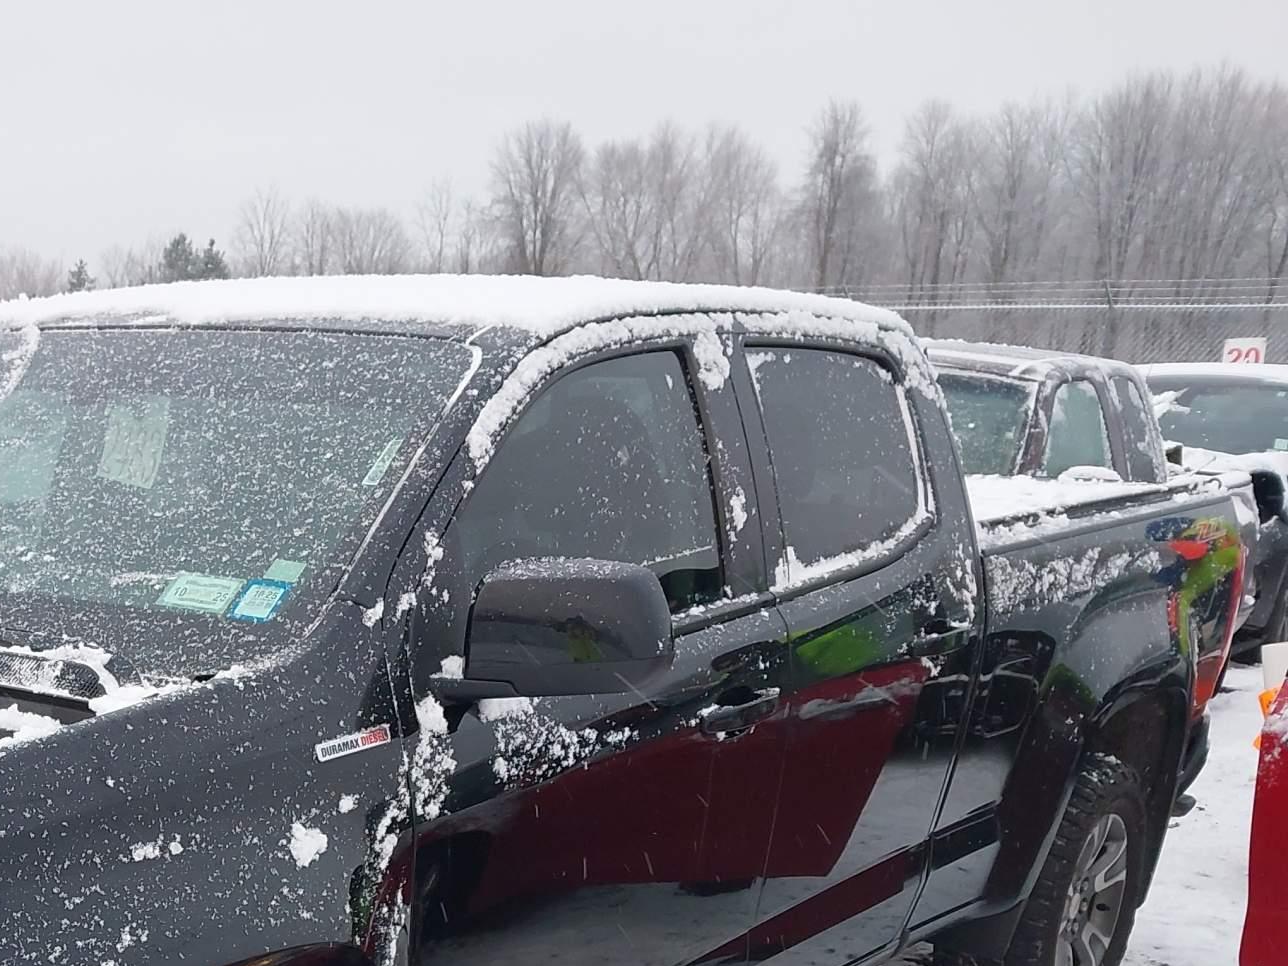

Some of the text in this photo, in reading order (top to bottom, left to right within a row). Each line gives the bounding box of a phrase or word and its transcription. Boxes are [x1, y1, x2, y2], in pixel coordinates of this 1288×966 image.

[1227, 346, 1260, 364] 20
[321, 727, 388, 758] DURAMAX DIESEL
